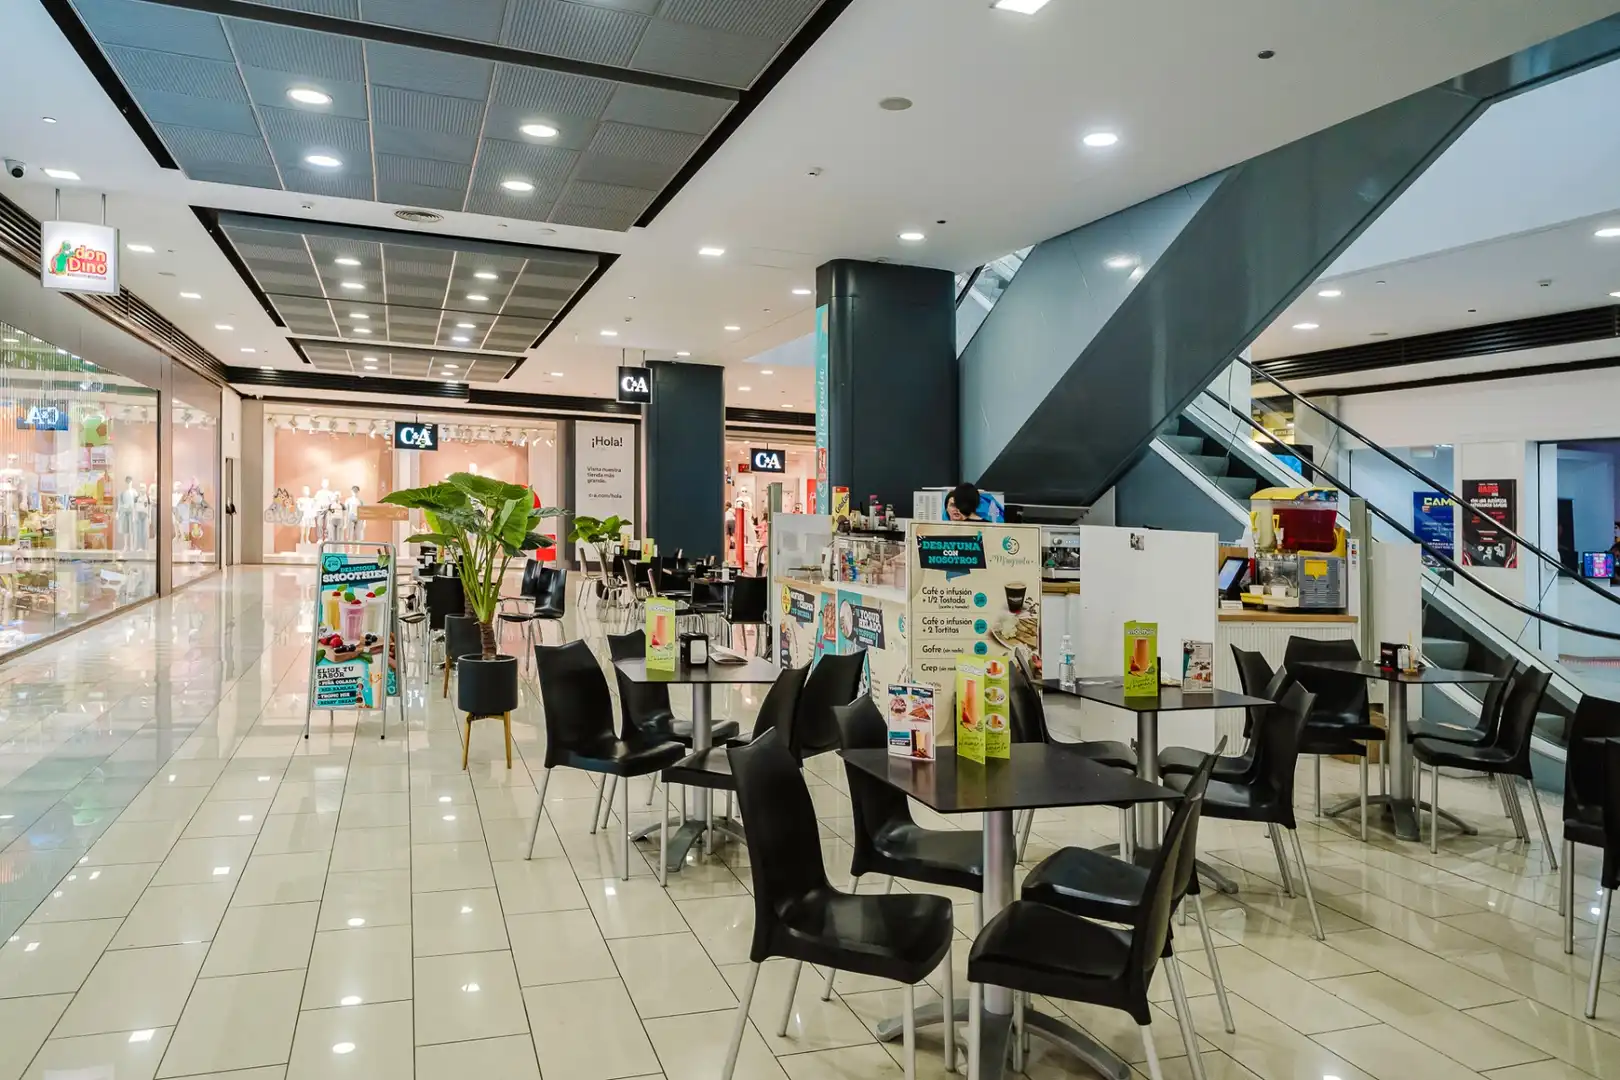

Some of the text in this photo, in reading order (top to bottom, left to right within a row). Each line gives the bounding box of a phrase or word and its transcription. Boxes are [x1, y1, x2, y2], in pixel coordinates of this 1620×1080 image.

[75, 245, 106, 262] don
[68, 257, 107, 275] Dino
[621, 376, 649, 393] C&A
[400, 427, 433, 446] C&A
[592, 436, 623, 448] ¡Hola!
[755, 452, 782, 469] C&A
[922, 540, 981, 551] DESAYUNA
[928, 556, 978, 565] NOSOTROS
[340, 565, 376, 573] DELICIOUS
[322, 569, 388, 583] SMOOTHIES
[922, 586, 939, 595] Café
[946, 587, 972, 596] infusión
[928, 596, 938, 604] 1/2
[939, 596, 966, 604] Tostada
[922, 616, 939, 625] Café
[946, 617, 973, 625] infusión
[927, 626, 933, 634] 2
[935, 626, 959, 634] Tortitas
[922, 644, 942, 653] Gofre
[317, 665, 354, 674] ELIGE TU
[921, 663, 938, 673] Crep
[317, 671, 345, 679] SABOR
